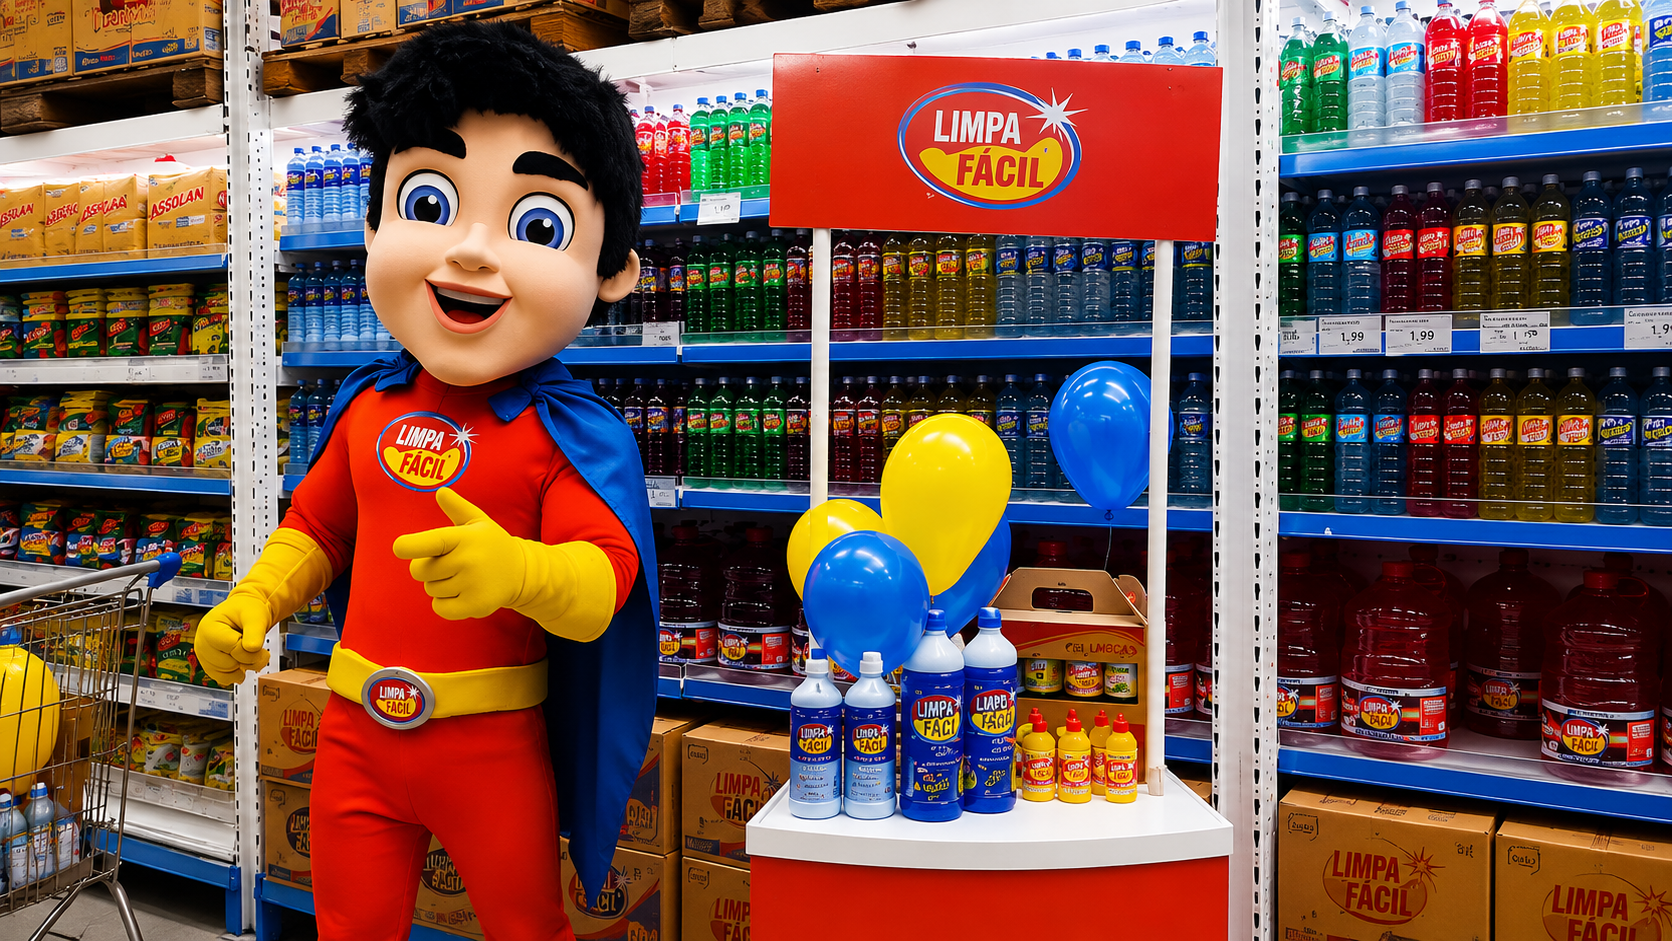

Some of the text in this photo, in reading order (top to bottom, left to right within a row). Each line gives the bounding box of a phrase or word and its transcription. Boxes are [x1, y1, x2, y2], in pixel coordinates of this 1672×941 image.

[933, 110, 1021, 144] LIMPA
[956, 147, 1044, 189] FÁCIL
[150, 186, 204, 221] ASSOLAN
[395, 424, 445, 451] LIMPA
[398, 451, 446, 481] FÁCIL
[379, 685, 405, 700] LIMPA
[283, 709, 314, 729] LIMPA
[917, 700, 953, 718] LIMPA
[715, 772, 761, 798] LIMPA
[1332, 850, 1400, 883] LIMPA
[714, 897, 751, 922] LIMP
[1345, 880, 1412, 917] FÁCIL
[1552, 884, 1628, 922] LIMPA
